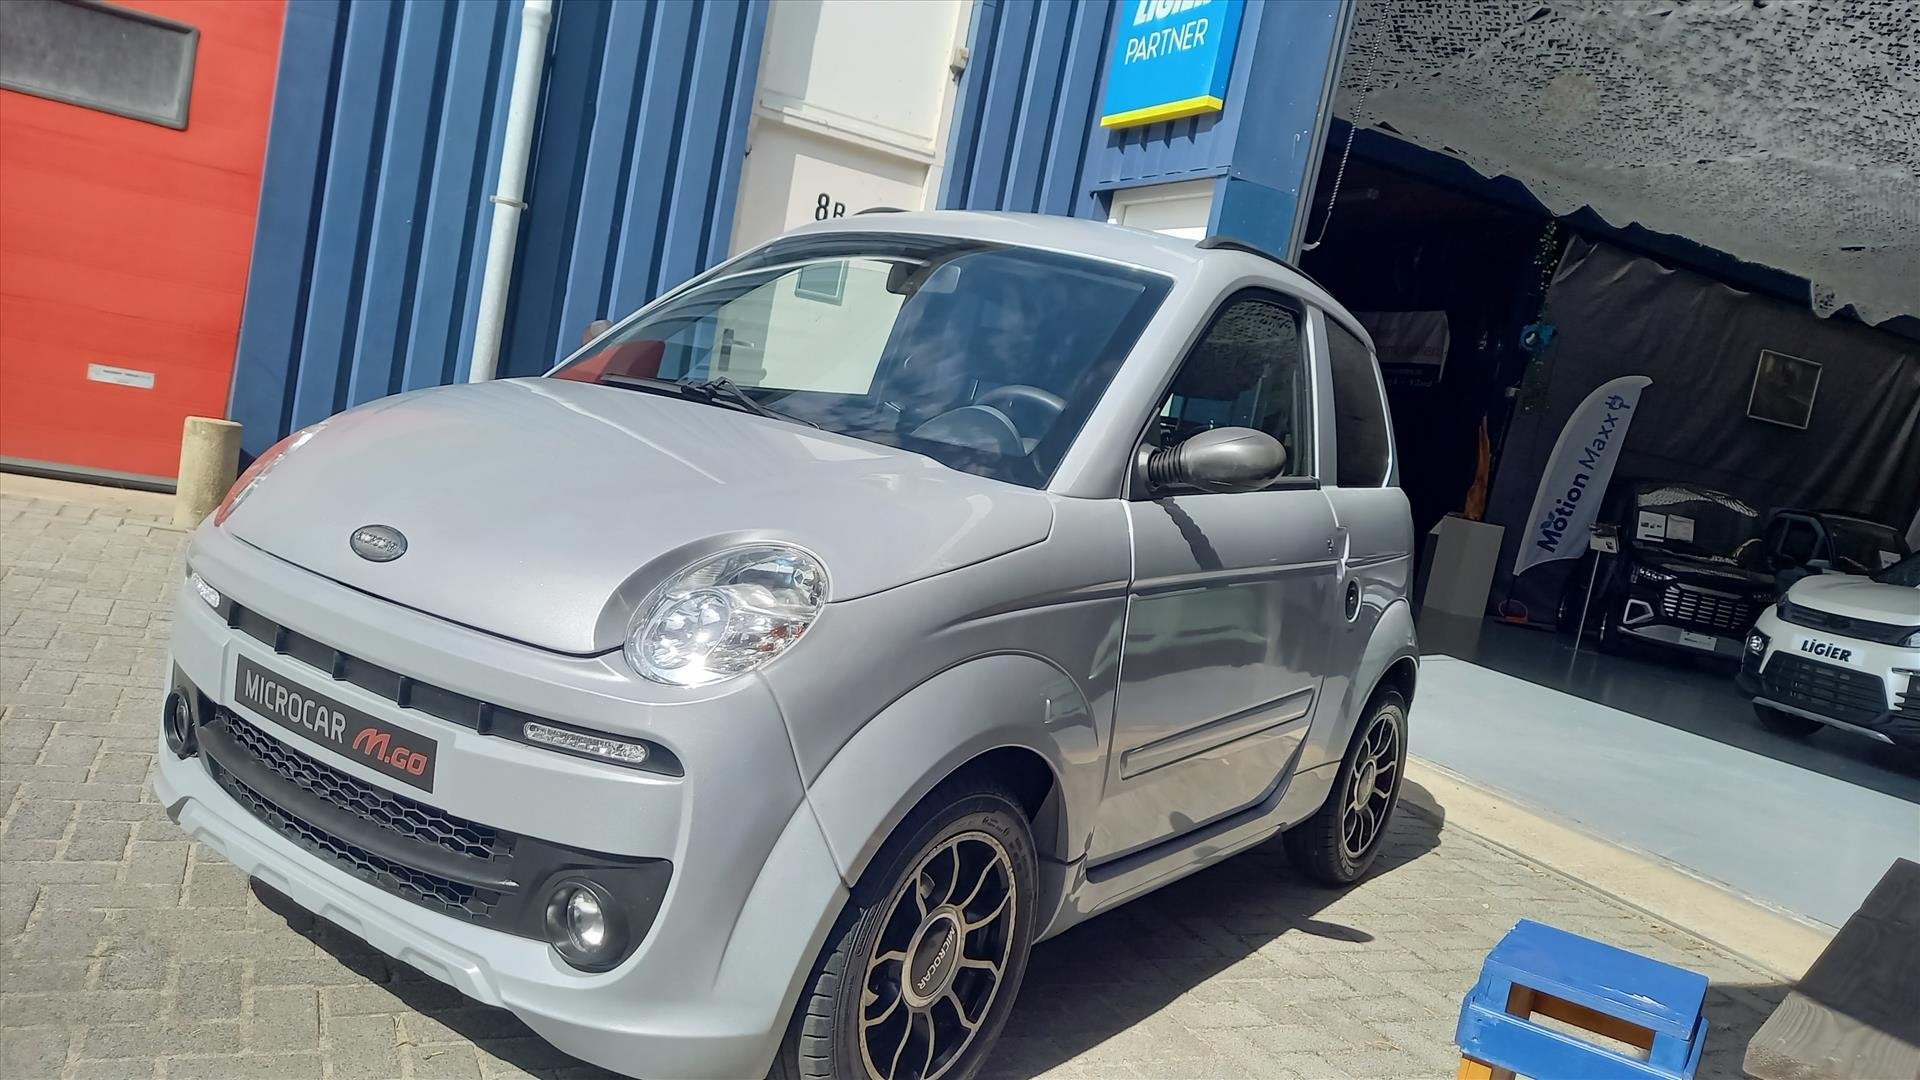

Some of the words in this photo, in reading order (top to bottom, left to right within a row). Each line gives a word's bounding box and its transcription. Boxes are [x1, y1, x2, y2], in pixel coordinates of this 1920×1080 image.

[1124, 17, 1209, 65] PARTNER
[1537, 473, 1590, 553] Motion
[1579, 413, 1619, 470] Maxx
[245, 669, 347, 744] MICROCAR
[352, 727, 428, 776] M.GO
[917, 927, 956, 990] MICROCAR
